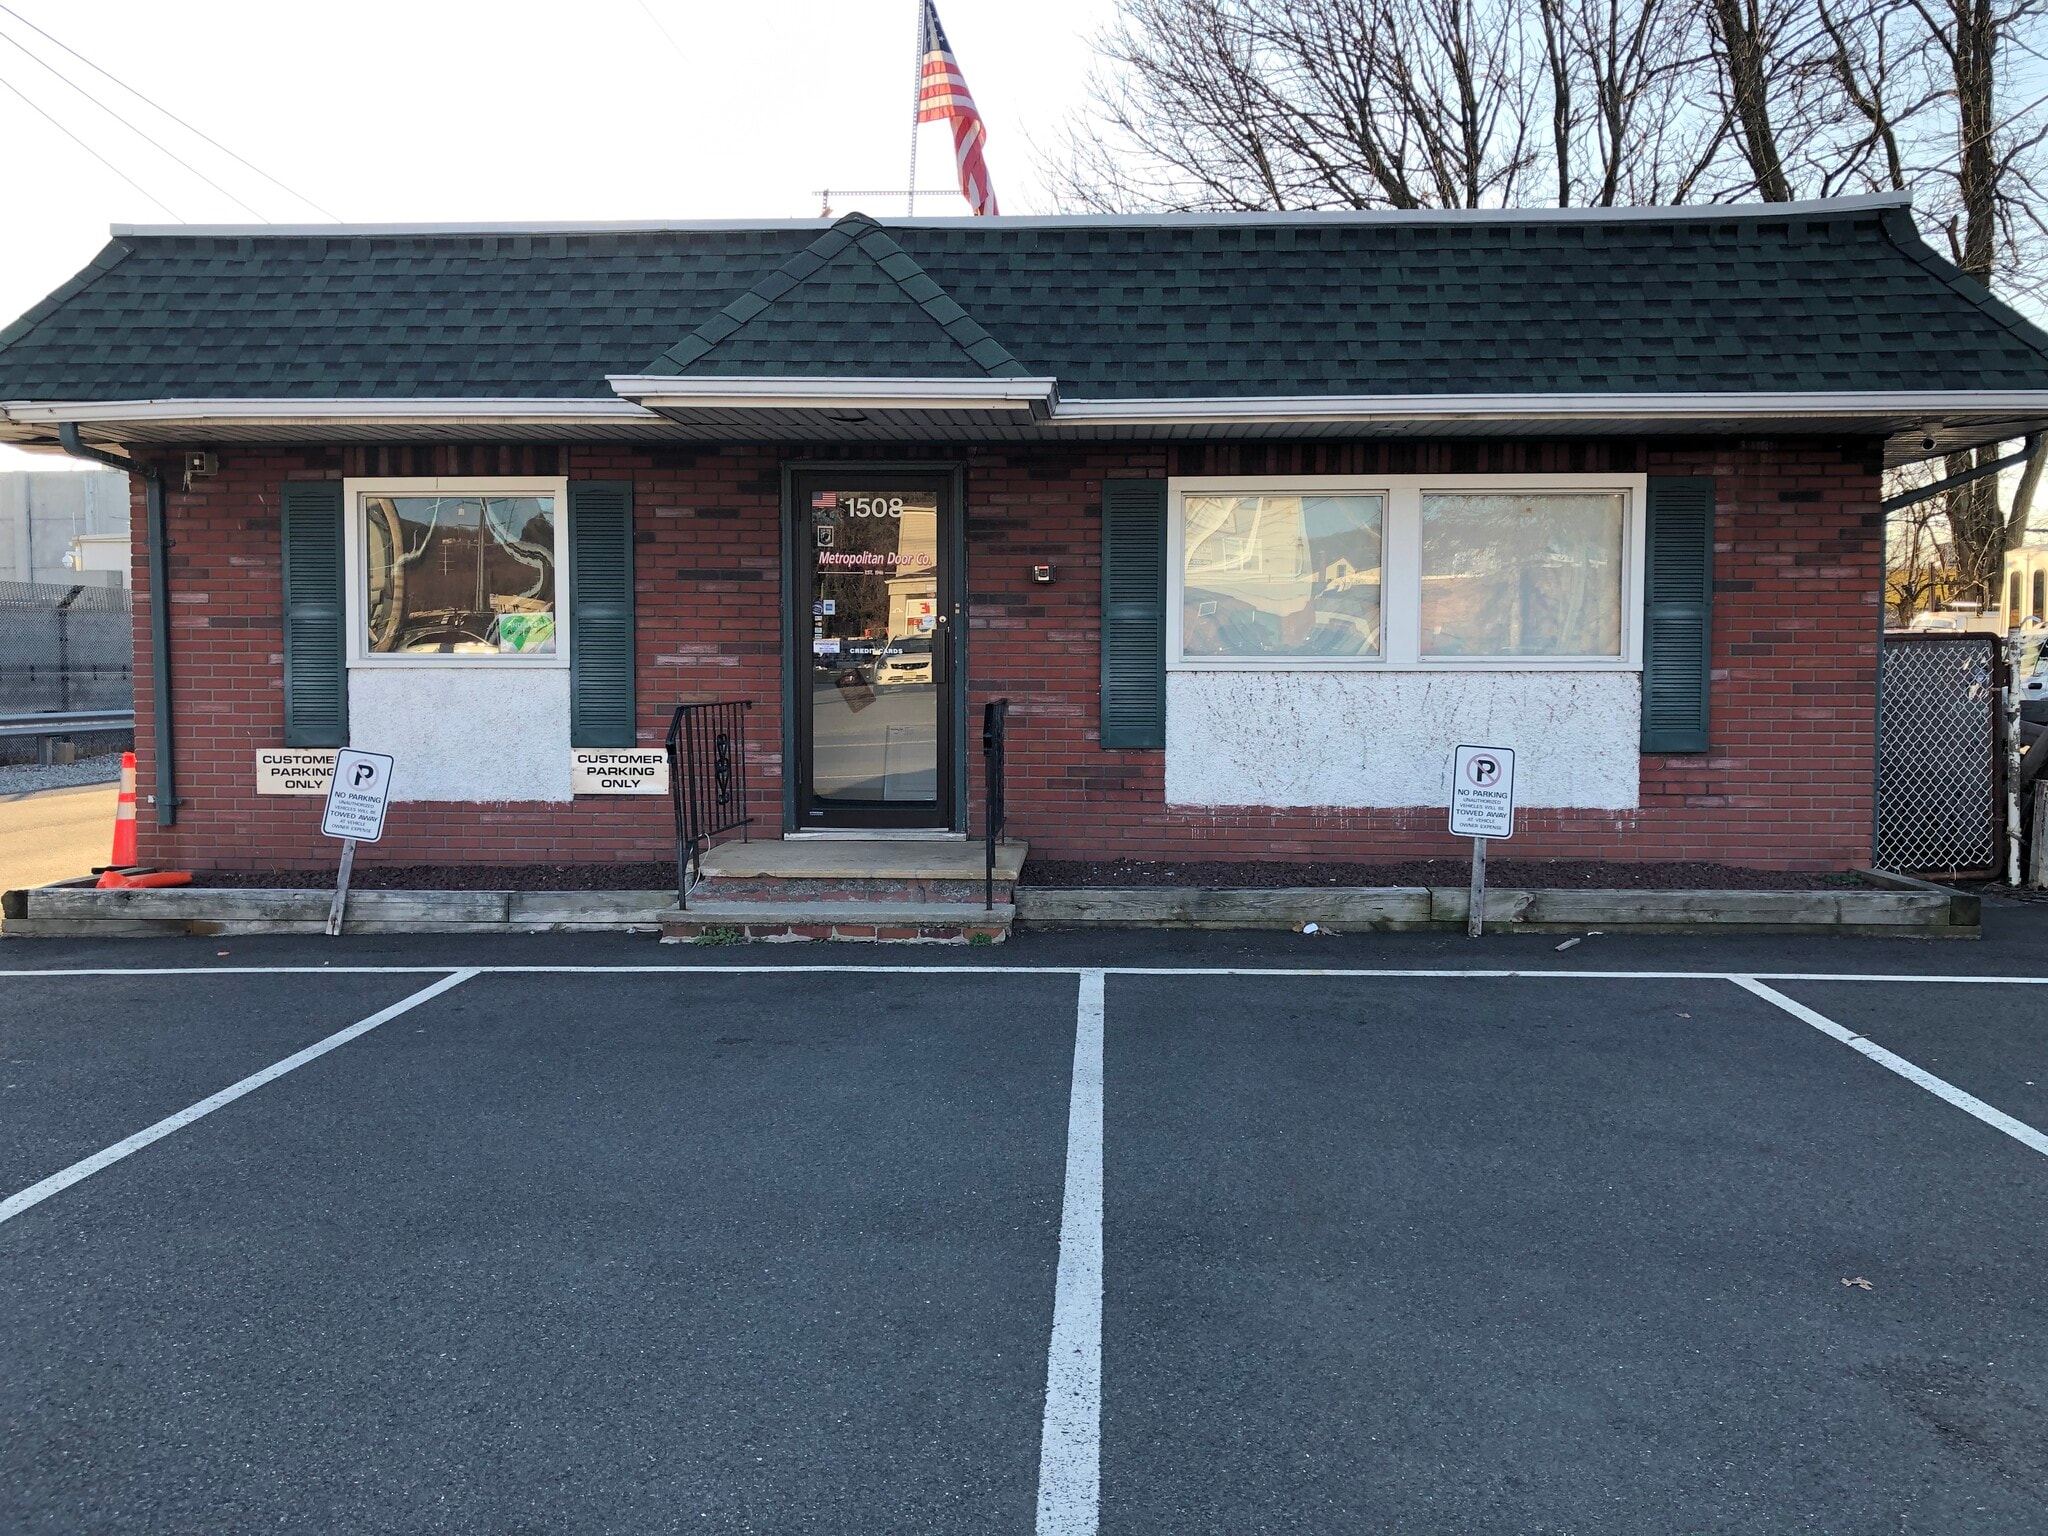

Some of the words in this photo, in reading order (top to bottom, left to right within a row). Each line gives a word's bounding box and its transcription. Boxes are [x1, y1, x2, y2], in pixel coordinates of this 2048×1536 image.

[845, 497, 904, 518] 1508
[819, 550, 884, 568] Metropolitan
[887, 552, 914, 566] Door
[916, 552, 933, 566] Co.
[262, 755, 337, 764] CUSTOME
[577, 754, 663, 764] CUSTOMER
[271, 767, 335, 777] PARKING
[586, 766, 656, 776] PARKING
[285, 780, 324, 789] ONLY
[601, 779, 641, 788] ONLY
[334, 791, 346, 799] NO
[348, 793, 381, 804] PARKING
[1457, 788, 1470, 796] NO
[1472, 789, 1508, 799] PARKING
[1462, 797, 1502, 805] UNAUTHORIZED
[334, 804, 356, 812] VEHICLES
[357, 807, 369, 815] WILL
[1456, 808, 1484, 817] TOWED
[1486, 811, 1508, 819] AWAY
[330, 810, 356, 820] TOWED
[358, 814, 379, 822] AWAY
